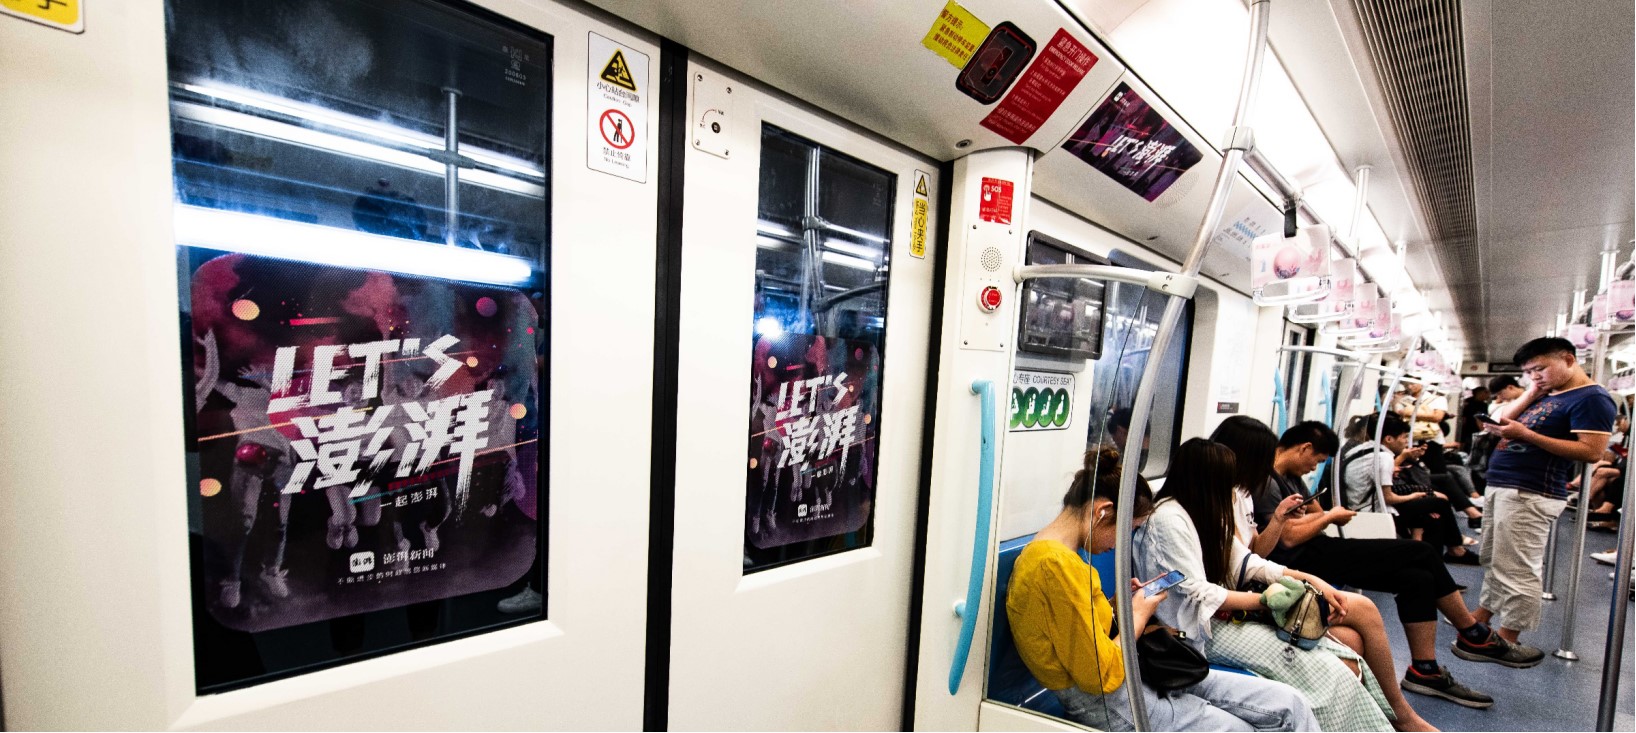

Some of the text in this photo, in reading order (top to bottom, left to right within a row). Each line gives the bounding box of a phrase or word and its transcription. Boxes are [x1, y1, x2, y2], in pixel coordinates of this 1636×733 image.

[991, 185, 1002, 193] SOS
[266, 334, 466, 414] LET'S
[775, 371, 849, 422] LET'S
[1032, 375, 1059, 385] COURTESY
[280, 389, 495, 515] 澎湃
[777, 405, 860, 484] 澎湃
[379, 486, 439, 508] 一起澎湃
